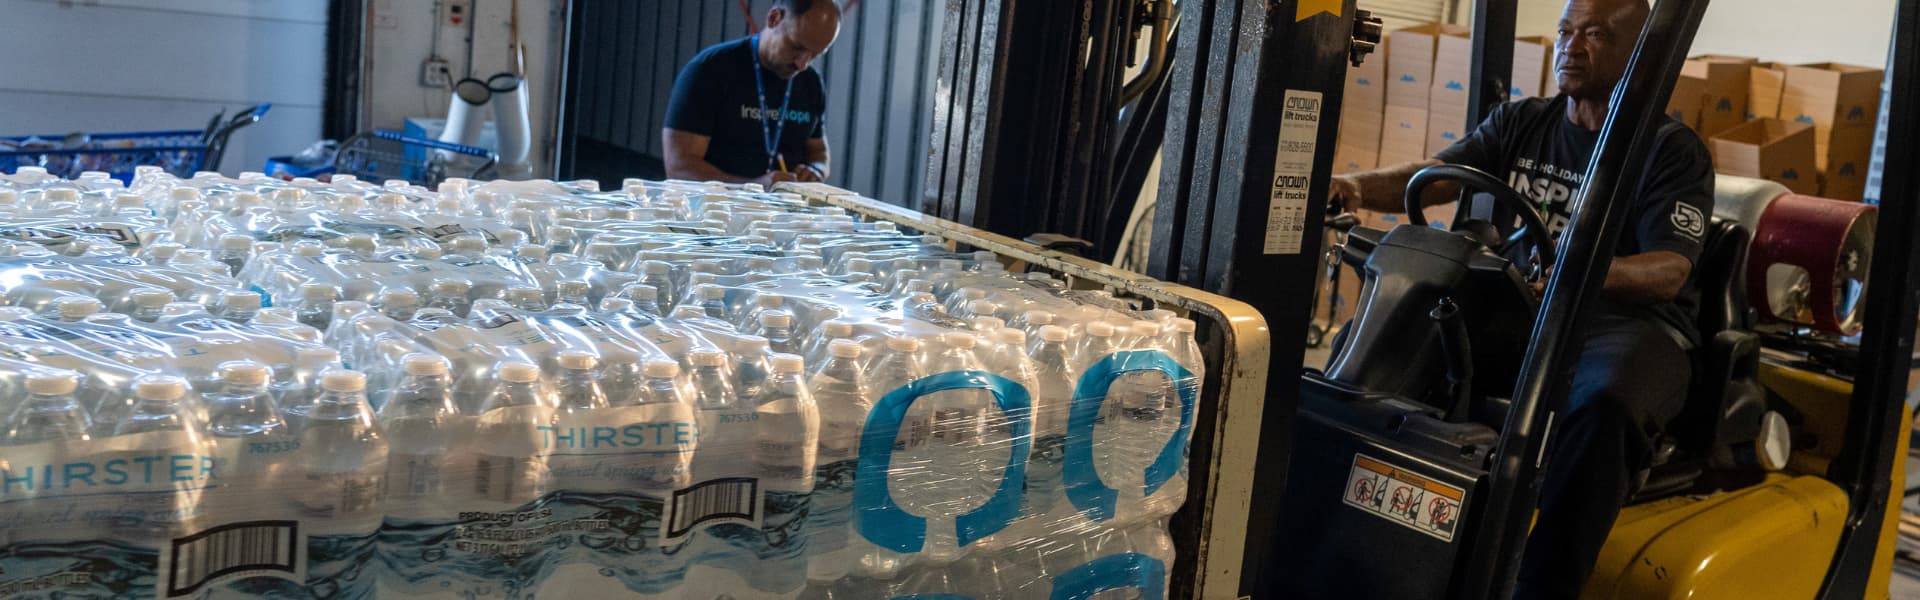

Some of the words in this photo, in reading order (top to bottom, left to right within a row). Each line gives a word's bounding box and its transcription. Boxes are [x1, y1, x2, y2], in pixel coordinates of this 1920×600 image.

[1285, 110, 1294, 120] lift
[1295, 112, 1317, 122] trucks
[1517, 157, 1534, 170] BE
[1273, 190, 1283, 199] lift
[1285, 190, 1306, 200] trucks
[459, 511, 514, 523] PRODUCT
